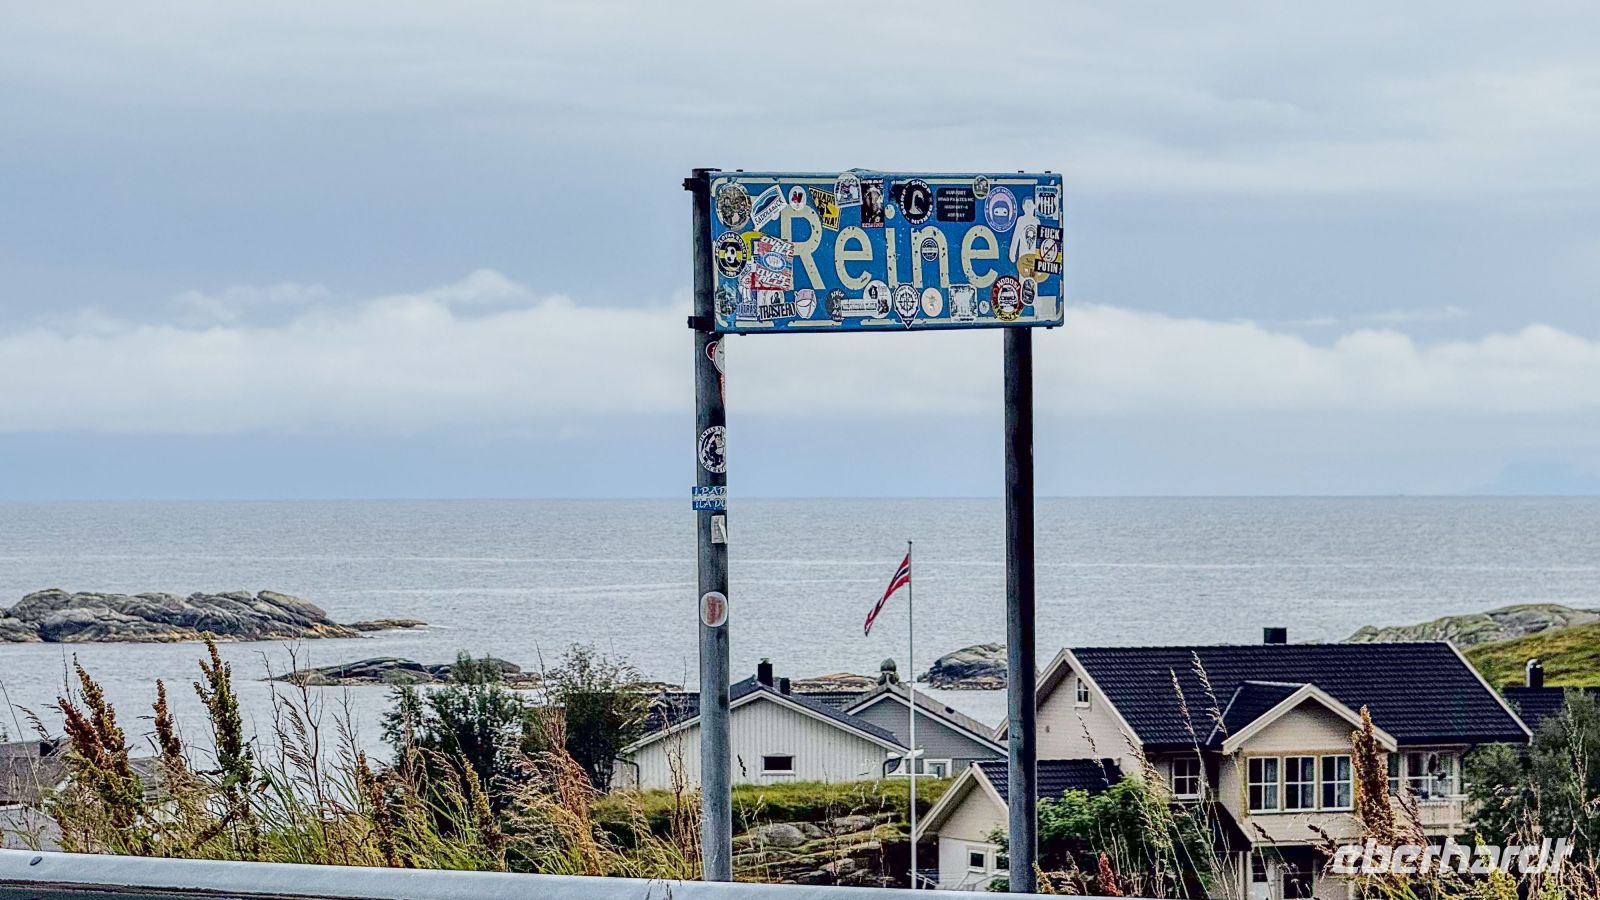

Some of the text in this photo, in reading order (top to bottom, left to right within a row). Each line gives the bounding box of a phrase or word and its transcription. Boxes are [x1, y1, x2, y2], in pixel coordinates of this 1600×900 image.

[1040, 226, 1061, 241] FUCK
[780, 205, 999, 290] Reine
[1037, 261, 1059, 274] PUTIN
